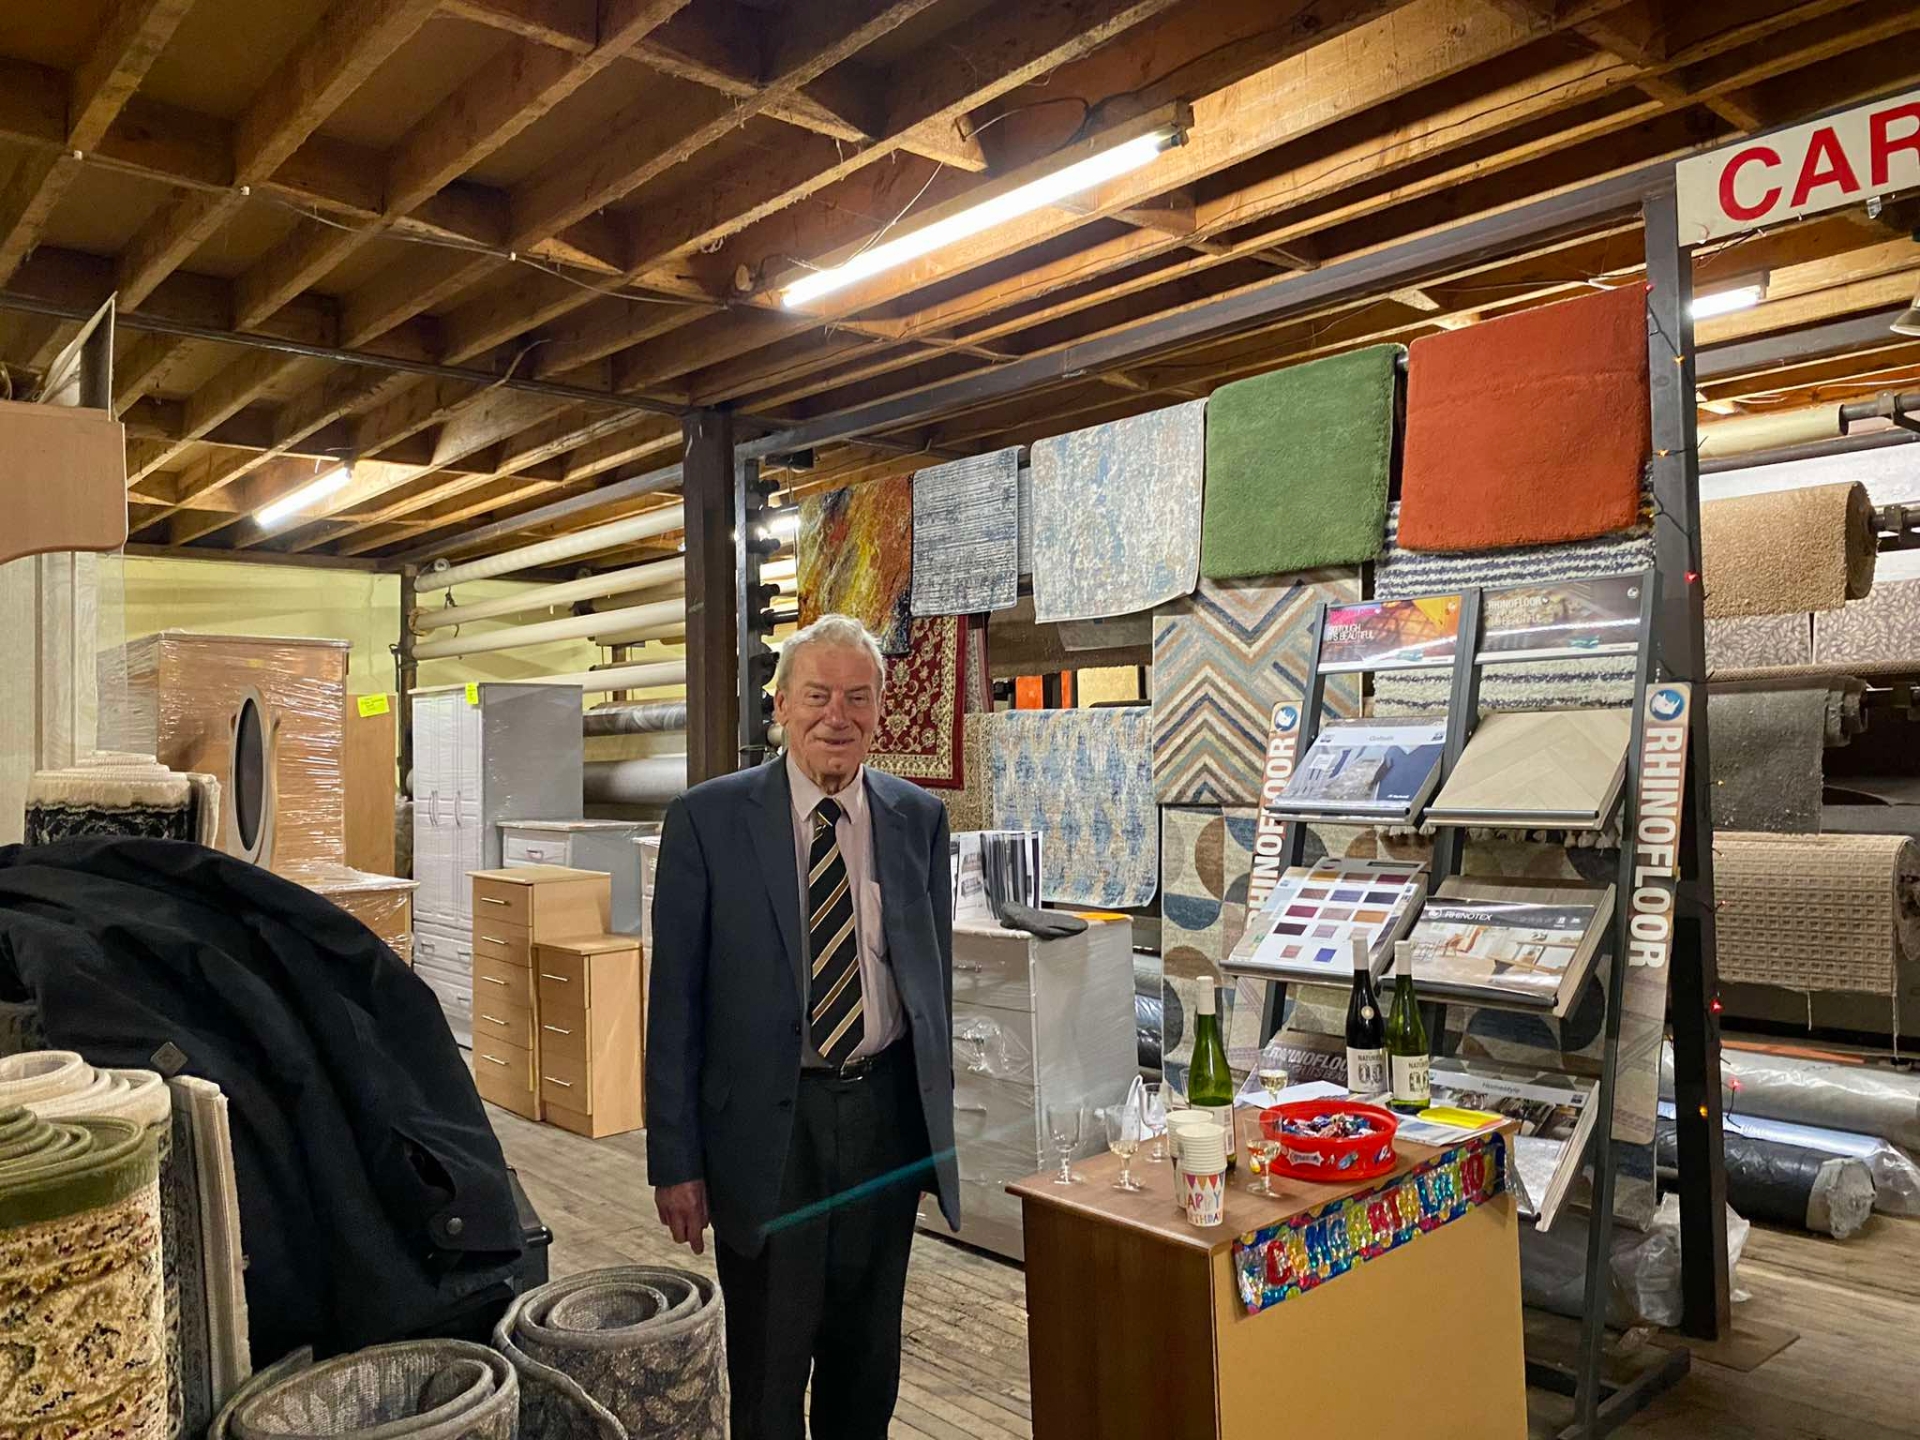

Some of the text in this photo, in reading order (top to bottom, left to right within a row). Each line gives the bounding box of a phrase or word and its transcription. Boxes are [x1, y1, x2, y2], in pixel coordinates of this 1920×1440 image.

[1718, 101, 1920, 222] CAR
[1340, 630, 1374, 641] BEAUTIFUL
[1246, 736, 1296, 930] HINOFOOR
[1629, 727, 1683, 968] RHINOFLOOR
[1444, 910, 1493, 922] RHINOTEX
[1482, 1082, 1521, 1095] Homestyle
[1185, 1191, 1221, 1211] APPY
